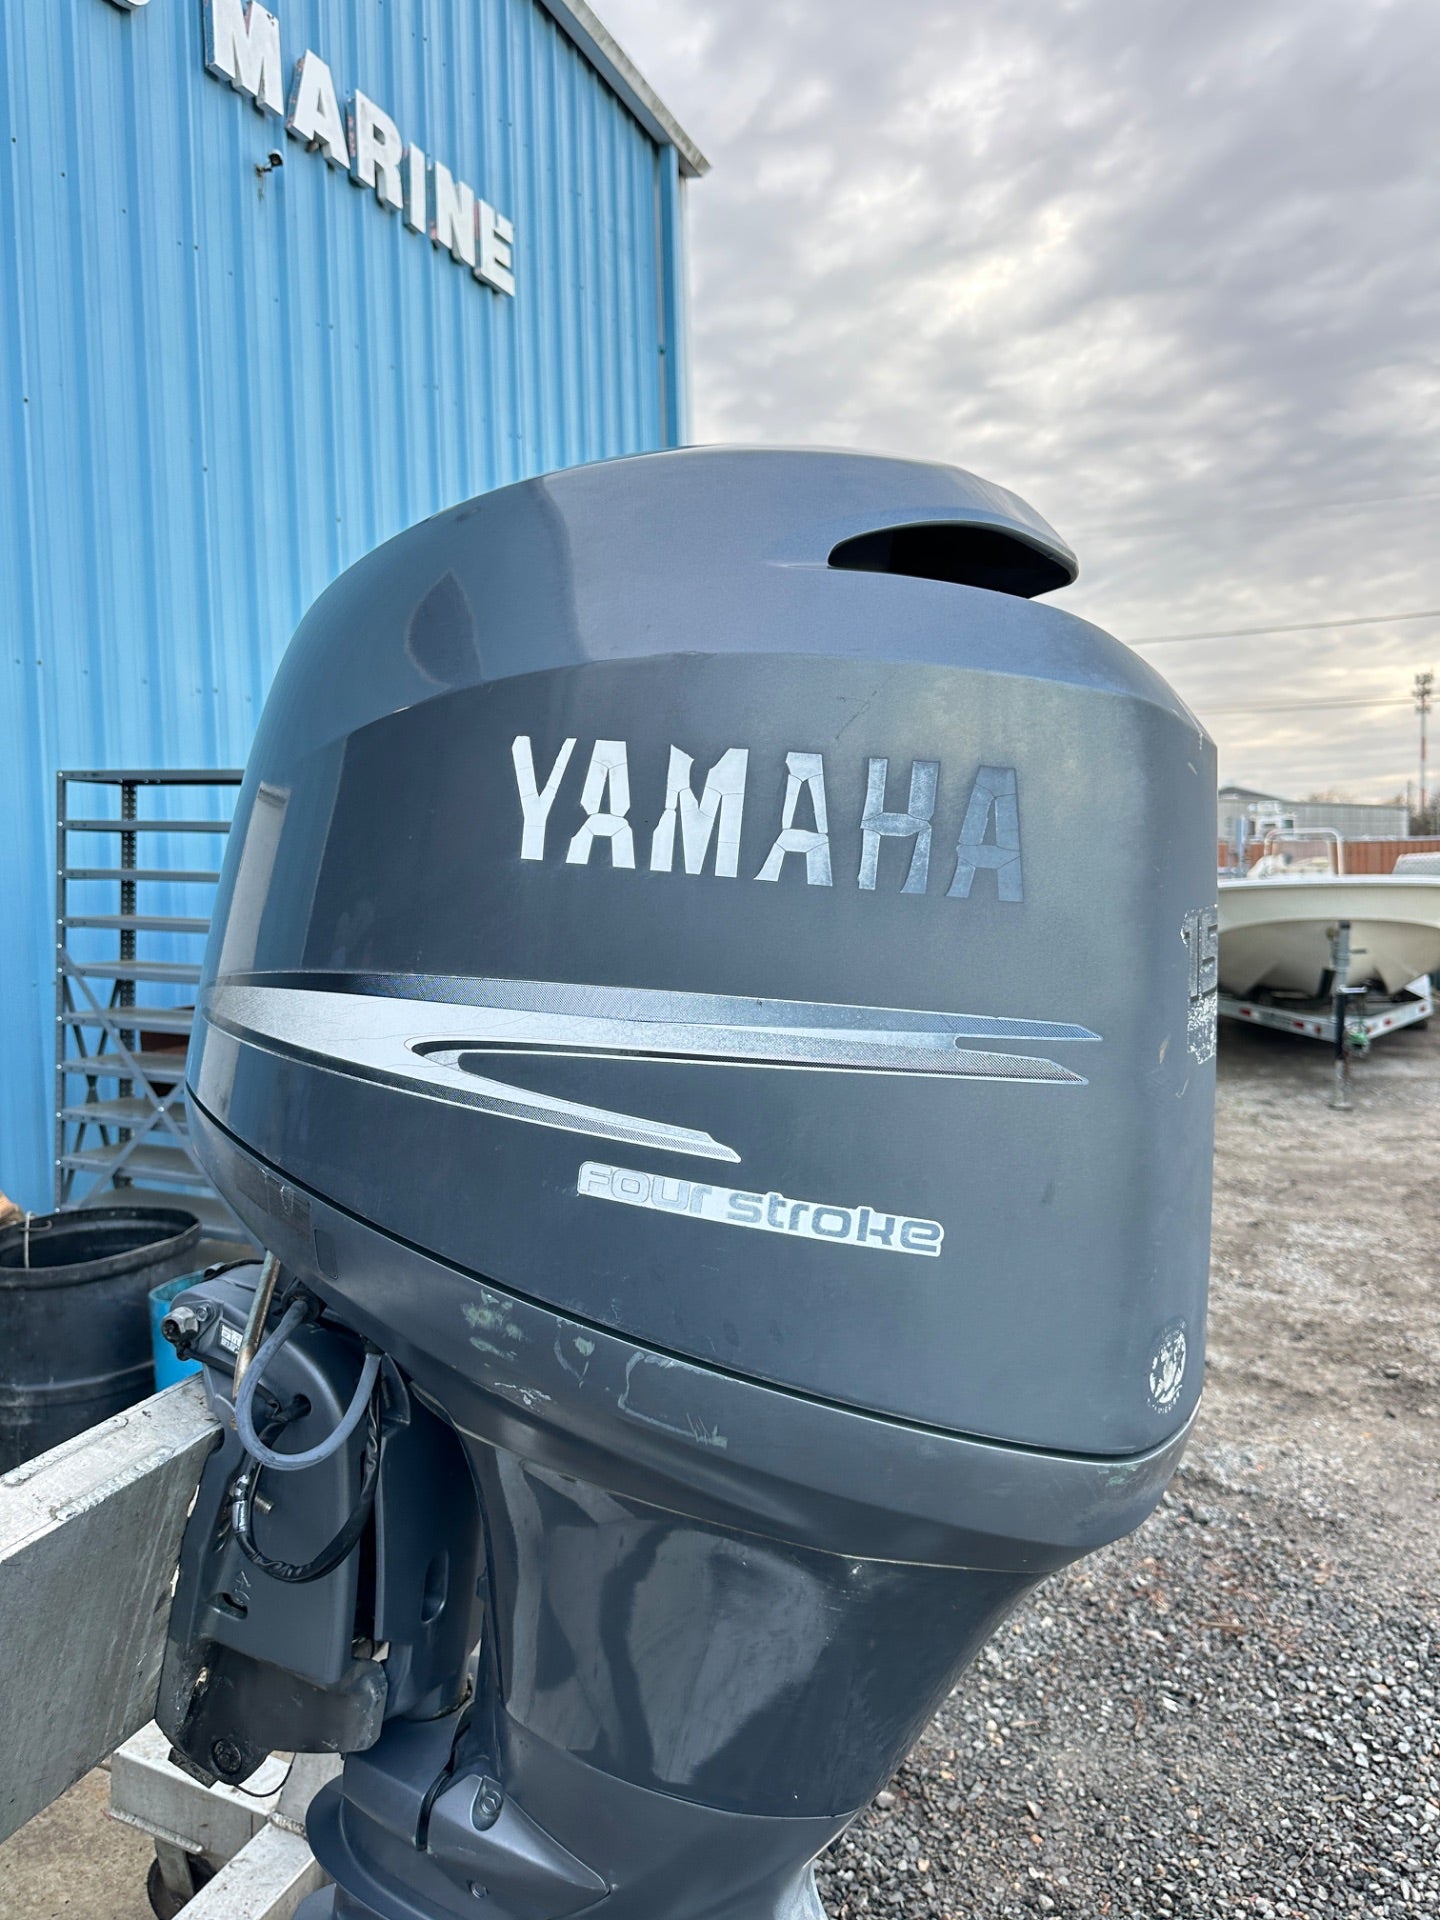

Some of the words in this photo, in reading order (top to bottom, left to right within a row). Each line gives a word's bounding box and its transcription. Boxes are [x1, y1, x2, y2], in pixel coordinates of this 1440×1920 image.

[205, 0, 515, 297] MARINE
[511, 735, 1024, 903] YAMAHA
[727, 1191, 943, 1253] stroke
